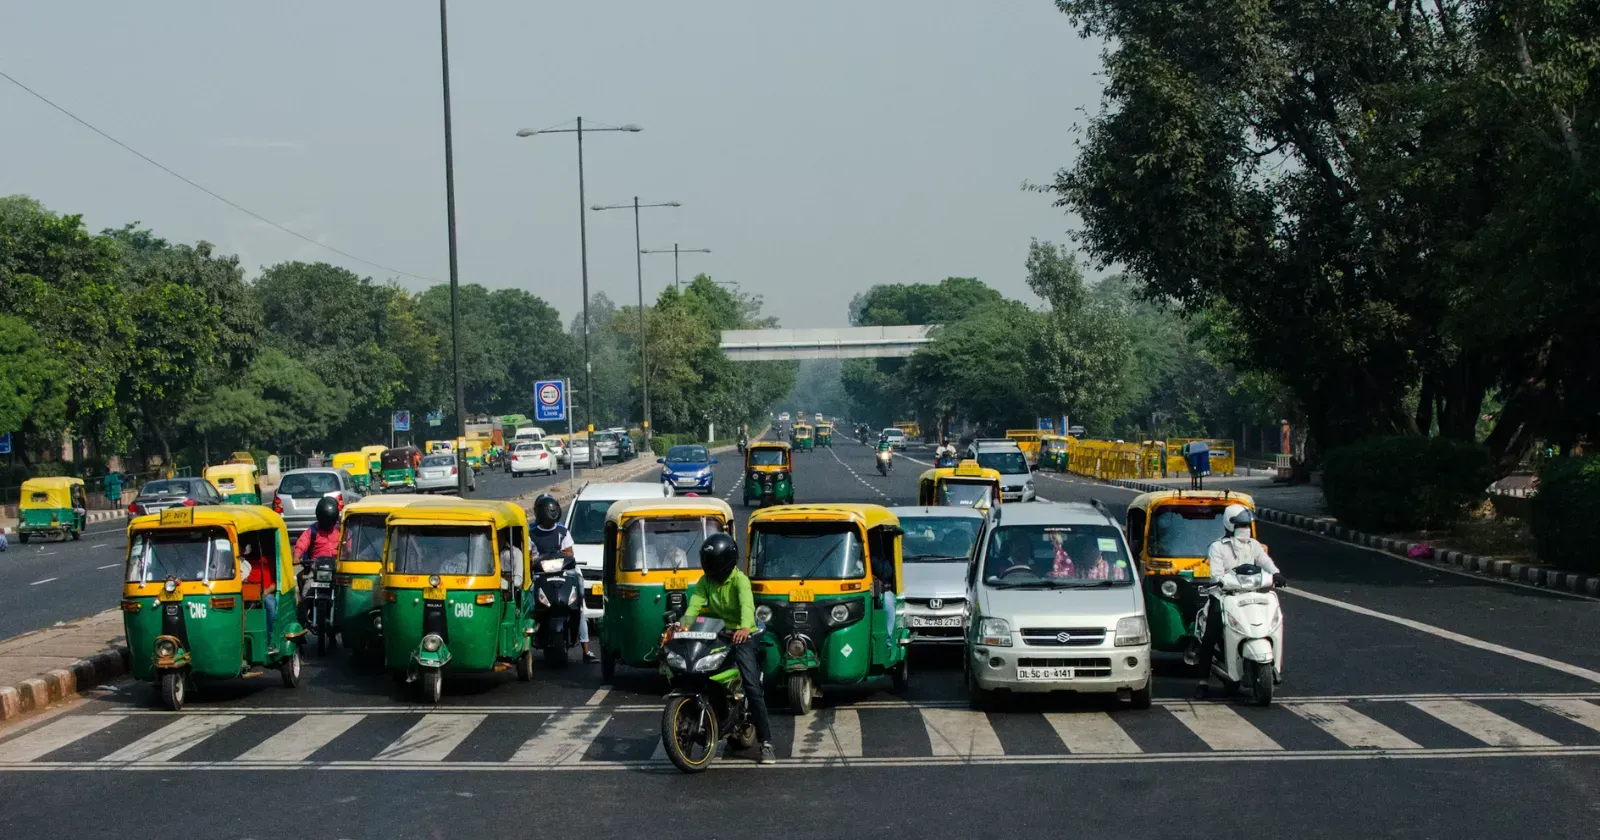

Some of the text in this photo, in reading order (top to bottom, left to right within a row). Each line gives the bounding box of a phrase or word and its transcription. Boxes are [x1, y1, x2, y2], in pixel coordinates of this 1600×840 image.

[190, 602, 207, 618] CNG
[454, 602, 474, 618] CNG
[944, 618, 960, 626] 2713
